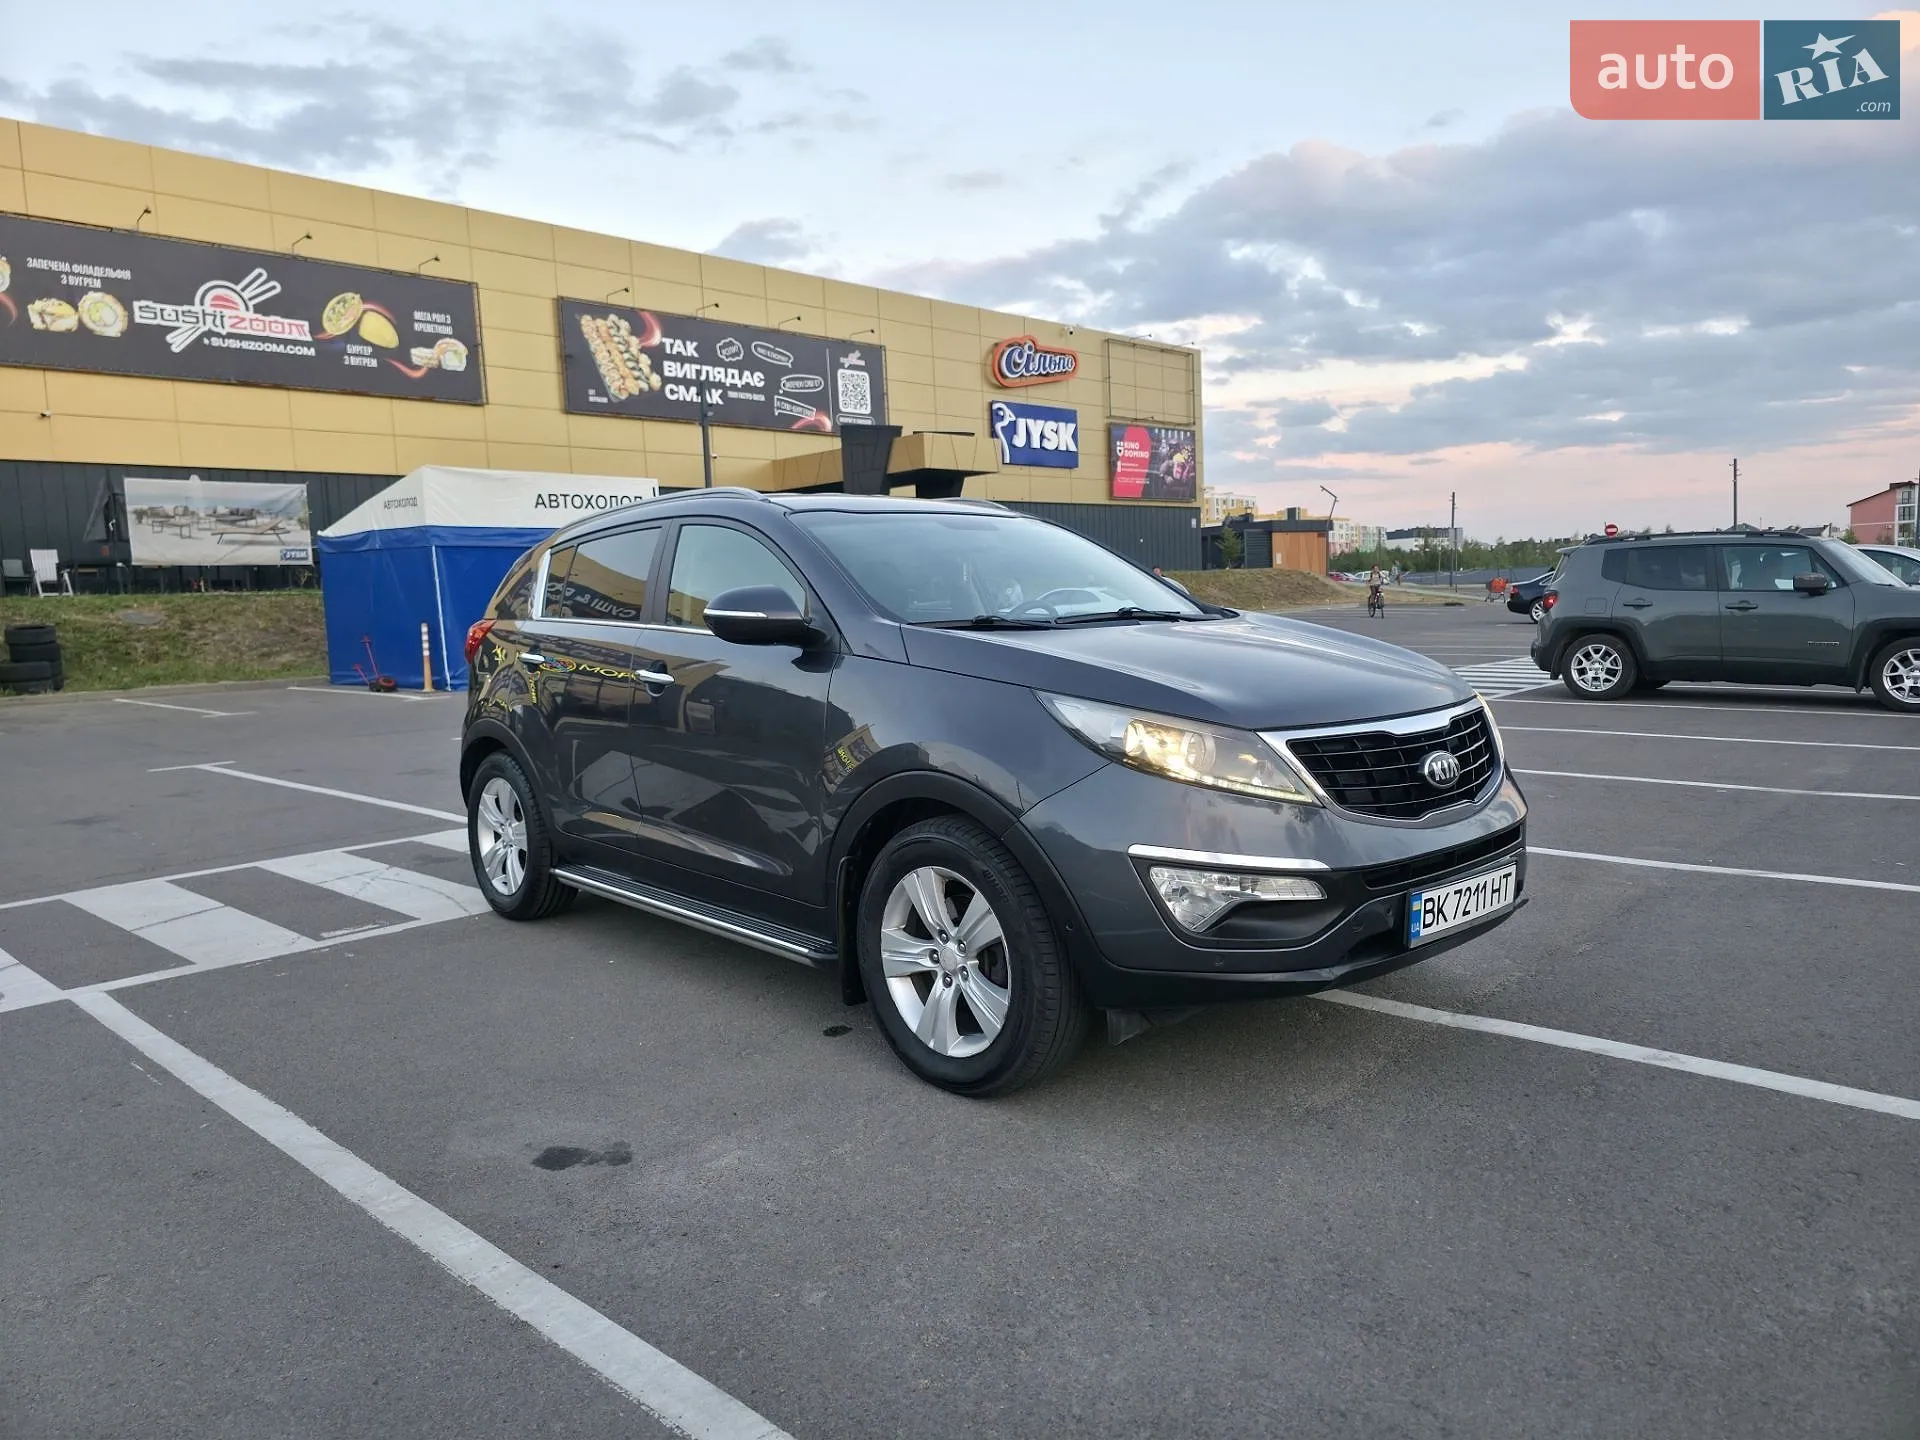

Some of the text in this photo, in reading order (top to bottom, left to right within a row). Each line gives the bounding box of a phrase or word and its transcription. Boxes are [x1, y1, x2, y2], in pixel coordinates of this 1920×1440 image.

[26, 257, 71, 273] ЗАПЕЧЕНА
[210, 336, 316, 357] SUSHIZOOM.COM
[661, 337, 699, 358] ТАК
[662, 360, 765, 388] ВИГЛЯДАЄ
[1012, 418, 1077, 452] JYSK
[535, 493, 643, 510] АВТОХОЛО
[1422, 871, 1513, 930] BK 7211 HT
